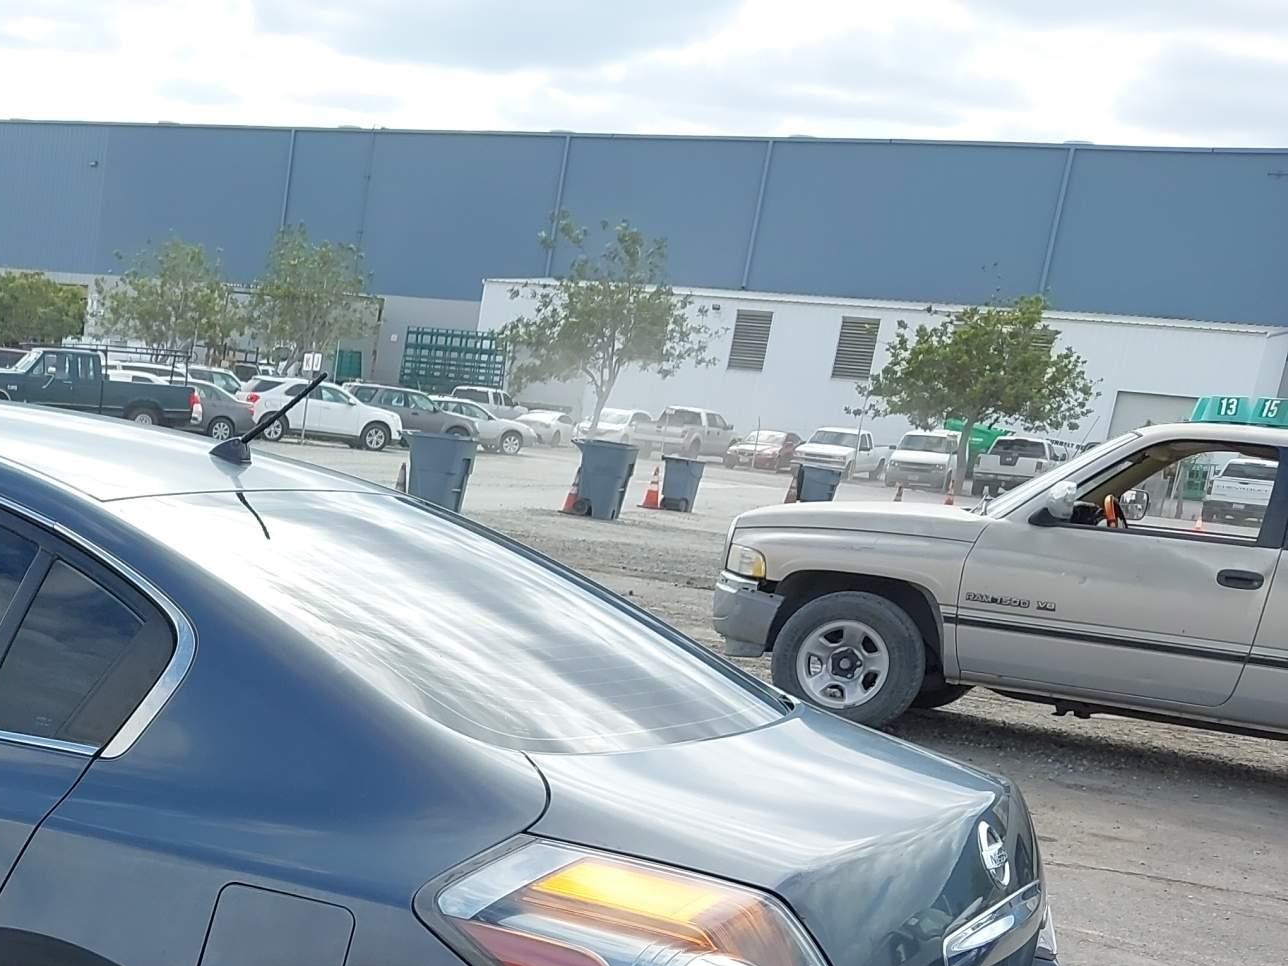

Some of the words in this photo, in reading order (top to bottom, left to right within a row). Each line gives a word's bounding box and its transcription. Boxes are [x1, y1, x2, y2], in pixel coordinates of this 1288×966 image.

[1220, 398, 1238, 415] 13
[1262, 400, 1280, 417] 15
[965, 592, 992, 603] RAM
[995, 595, 1030, 608] 1500
[1036, 600, 1056, 611] V8
